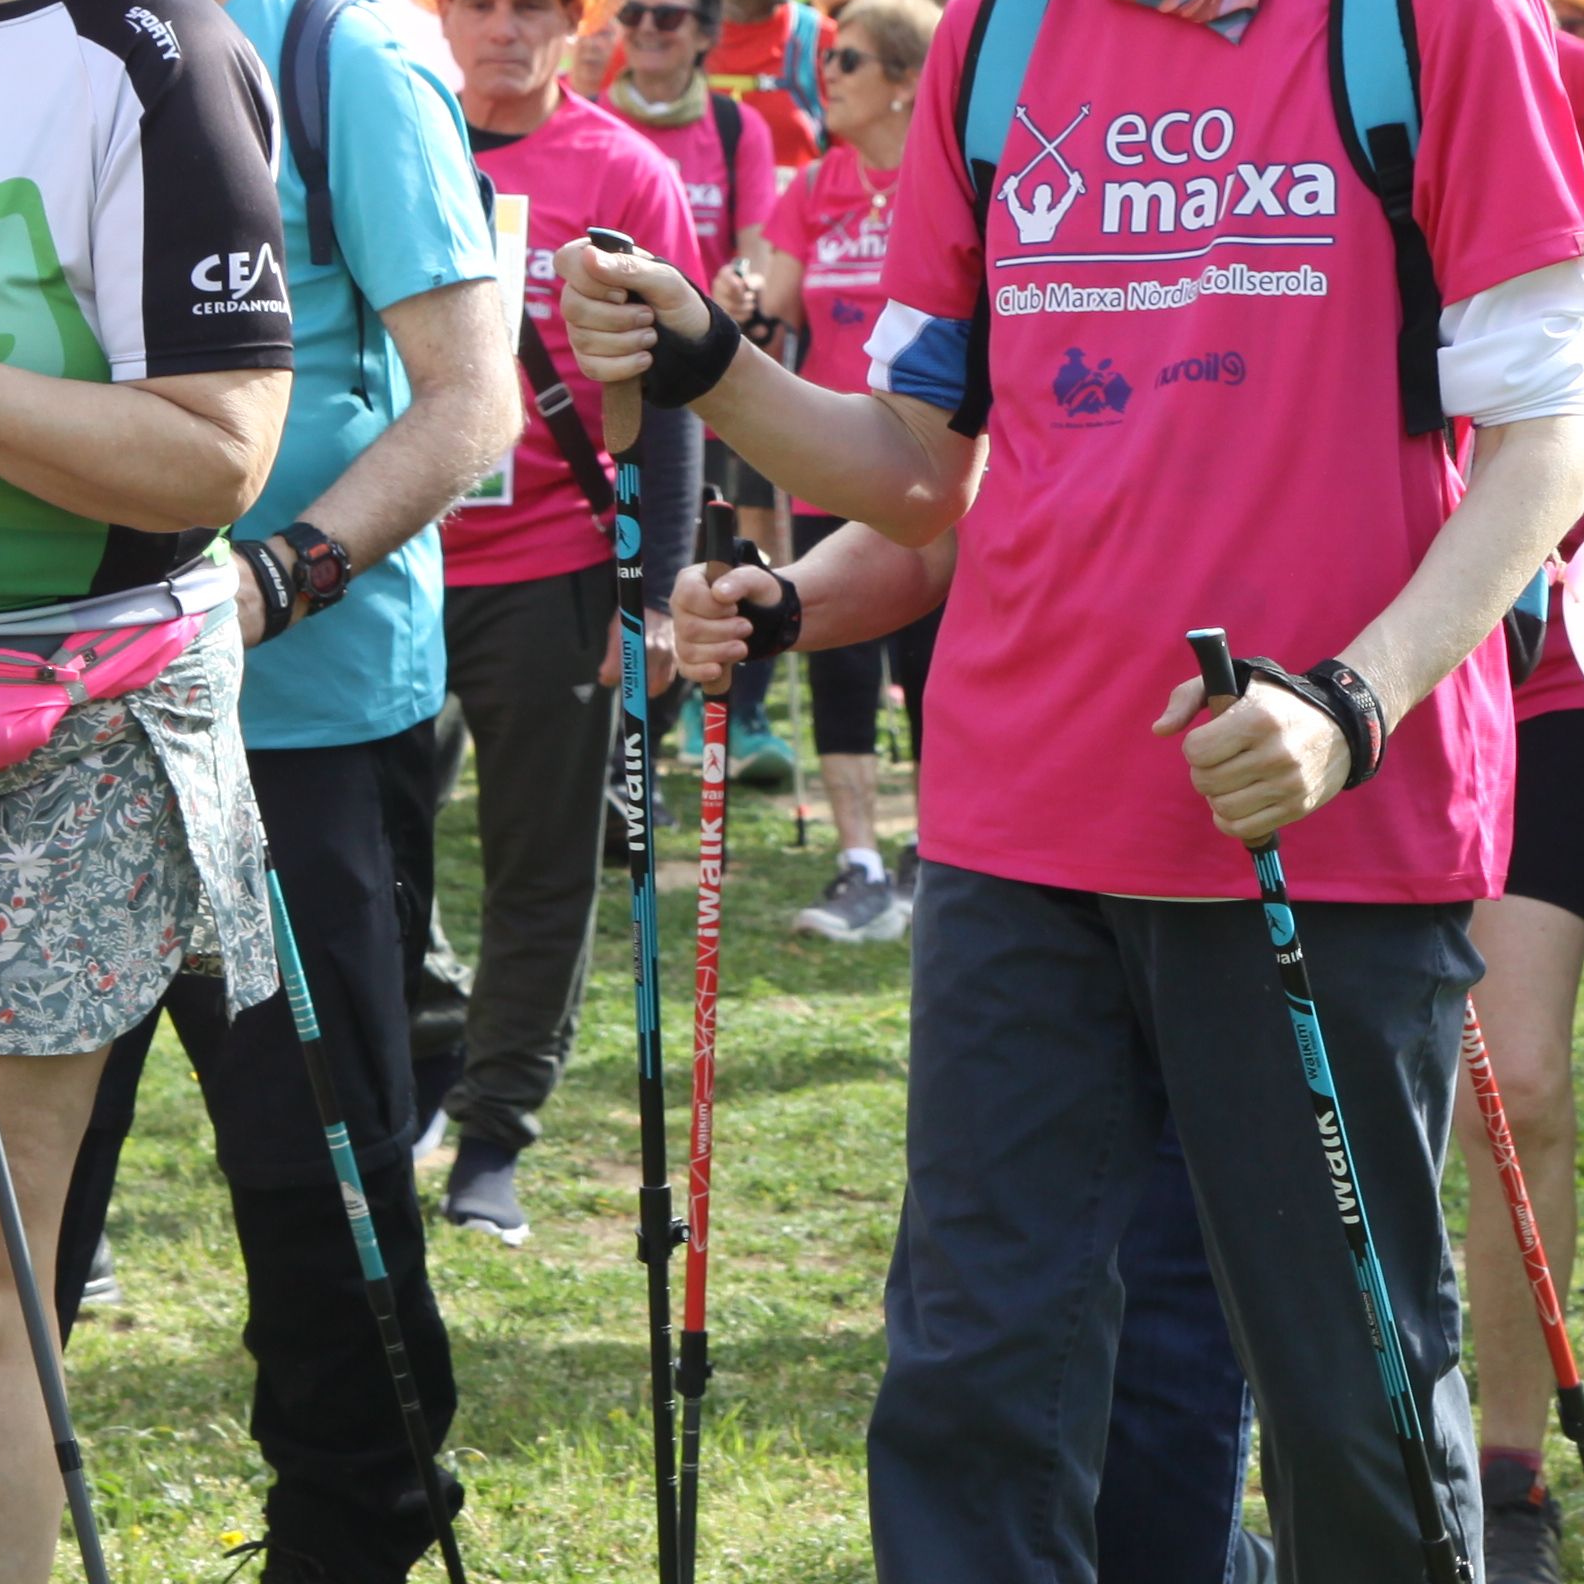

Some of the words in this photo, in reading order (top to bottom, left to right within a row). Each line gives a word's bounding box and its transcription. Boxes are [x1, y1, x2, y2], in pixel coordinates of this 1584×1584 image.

[124, 6, 182, 60] SPORTY
[1104, 106, 1235, 167] eco
[996, 284, 1043, 315] Club
[1045, 282, 1124, 312] Marxa
[1127, 278, 1200, 312] Nòrdic
[1198, 264, 1328, 296] Collserola
[697, 816, 723, 938] iwalk
